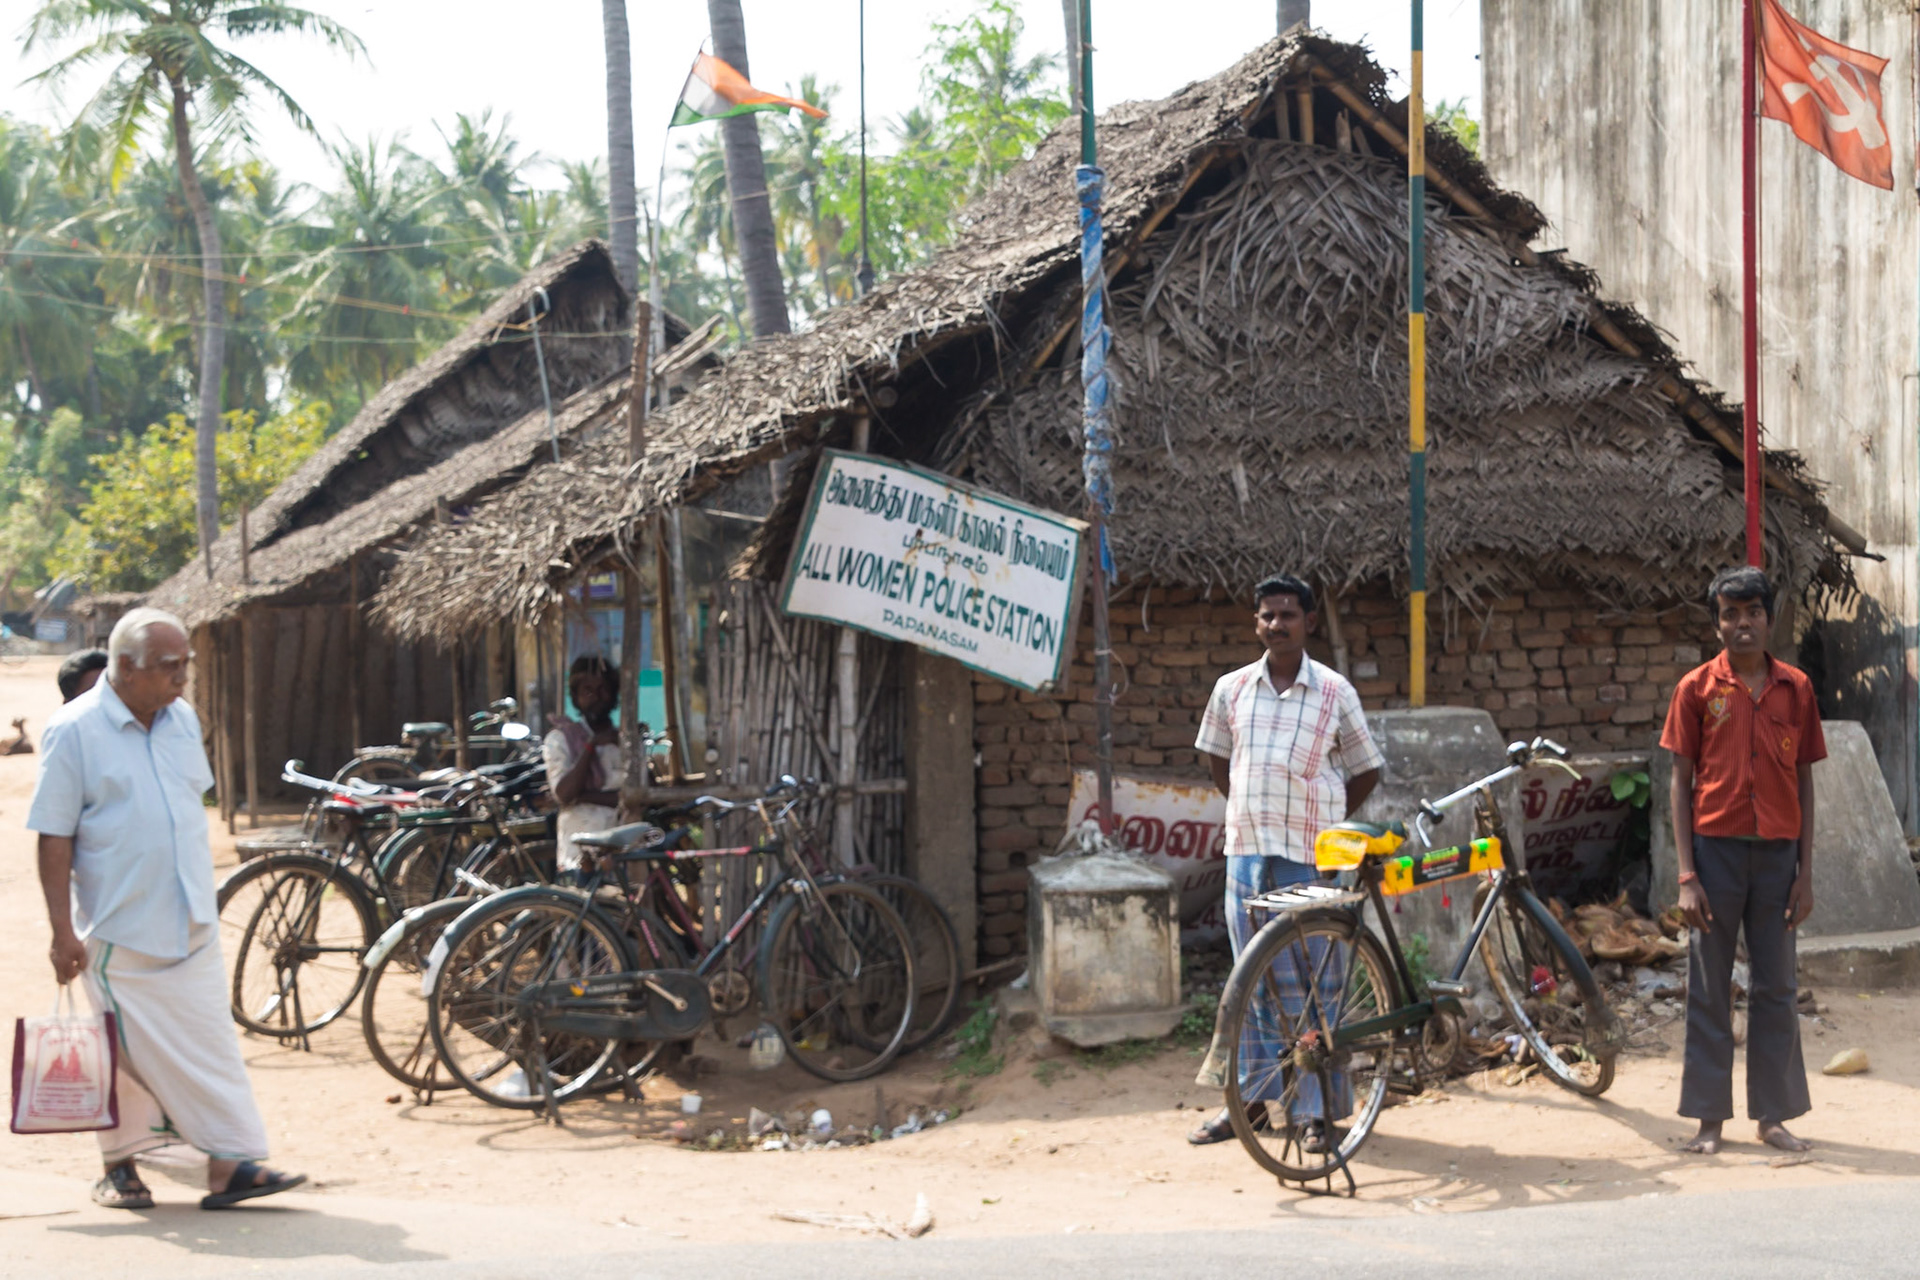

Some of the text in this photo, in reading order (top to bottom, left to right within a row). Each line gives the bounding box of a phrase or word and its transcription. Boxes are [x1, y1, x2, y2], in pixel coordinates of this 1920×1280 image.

[958, 515, 1007, 556] காவல்
[799, 542, 1058, 657] ALL WOMEN POLICE STATION
[882, 608, 978, 654] PAPANASAM
